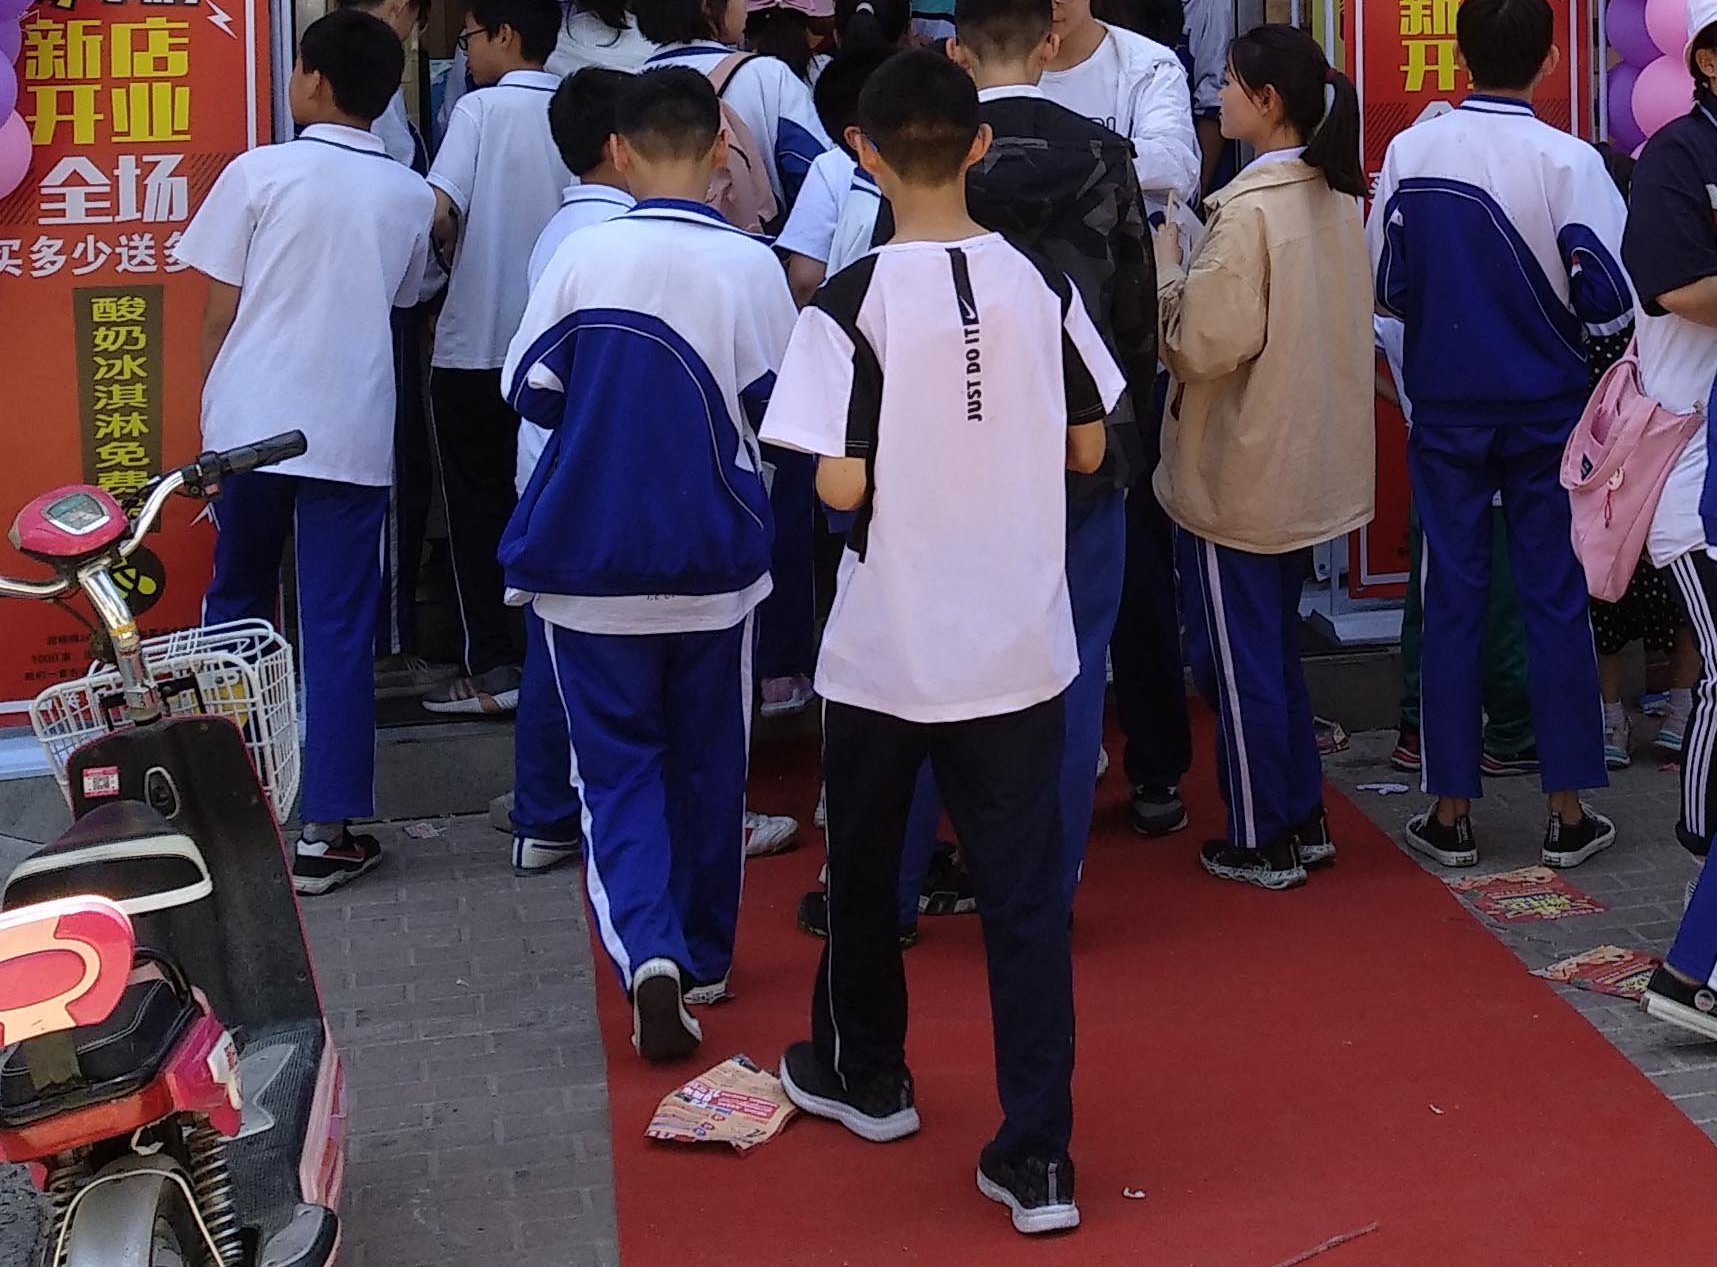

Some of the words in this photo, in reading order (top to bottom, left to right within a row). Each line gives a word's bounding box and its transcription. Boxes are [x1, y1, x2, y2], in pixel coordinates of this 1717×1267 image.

[24, 16, 191, 80] 新店
[1400, 38, 1474, 92] 开
[25, 81, 192, 146] 开业
[38, 154, 190, 225] 全场
[964, 328, 980, 344] IT
[965, 348, 981, 374] DO
[90, 295, 149, 518] 酸奶冰淇淋免费
[967, 380, 983, 422] JUST
